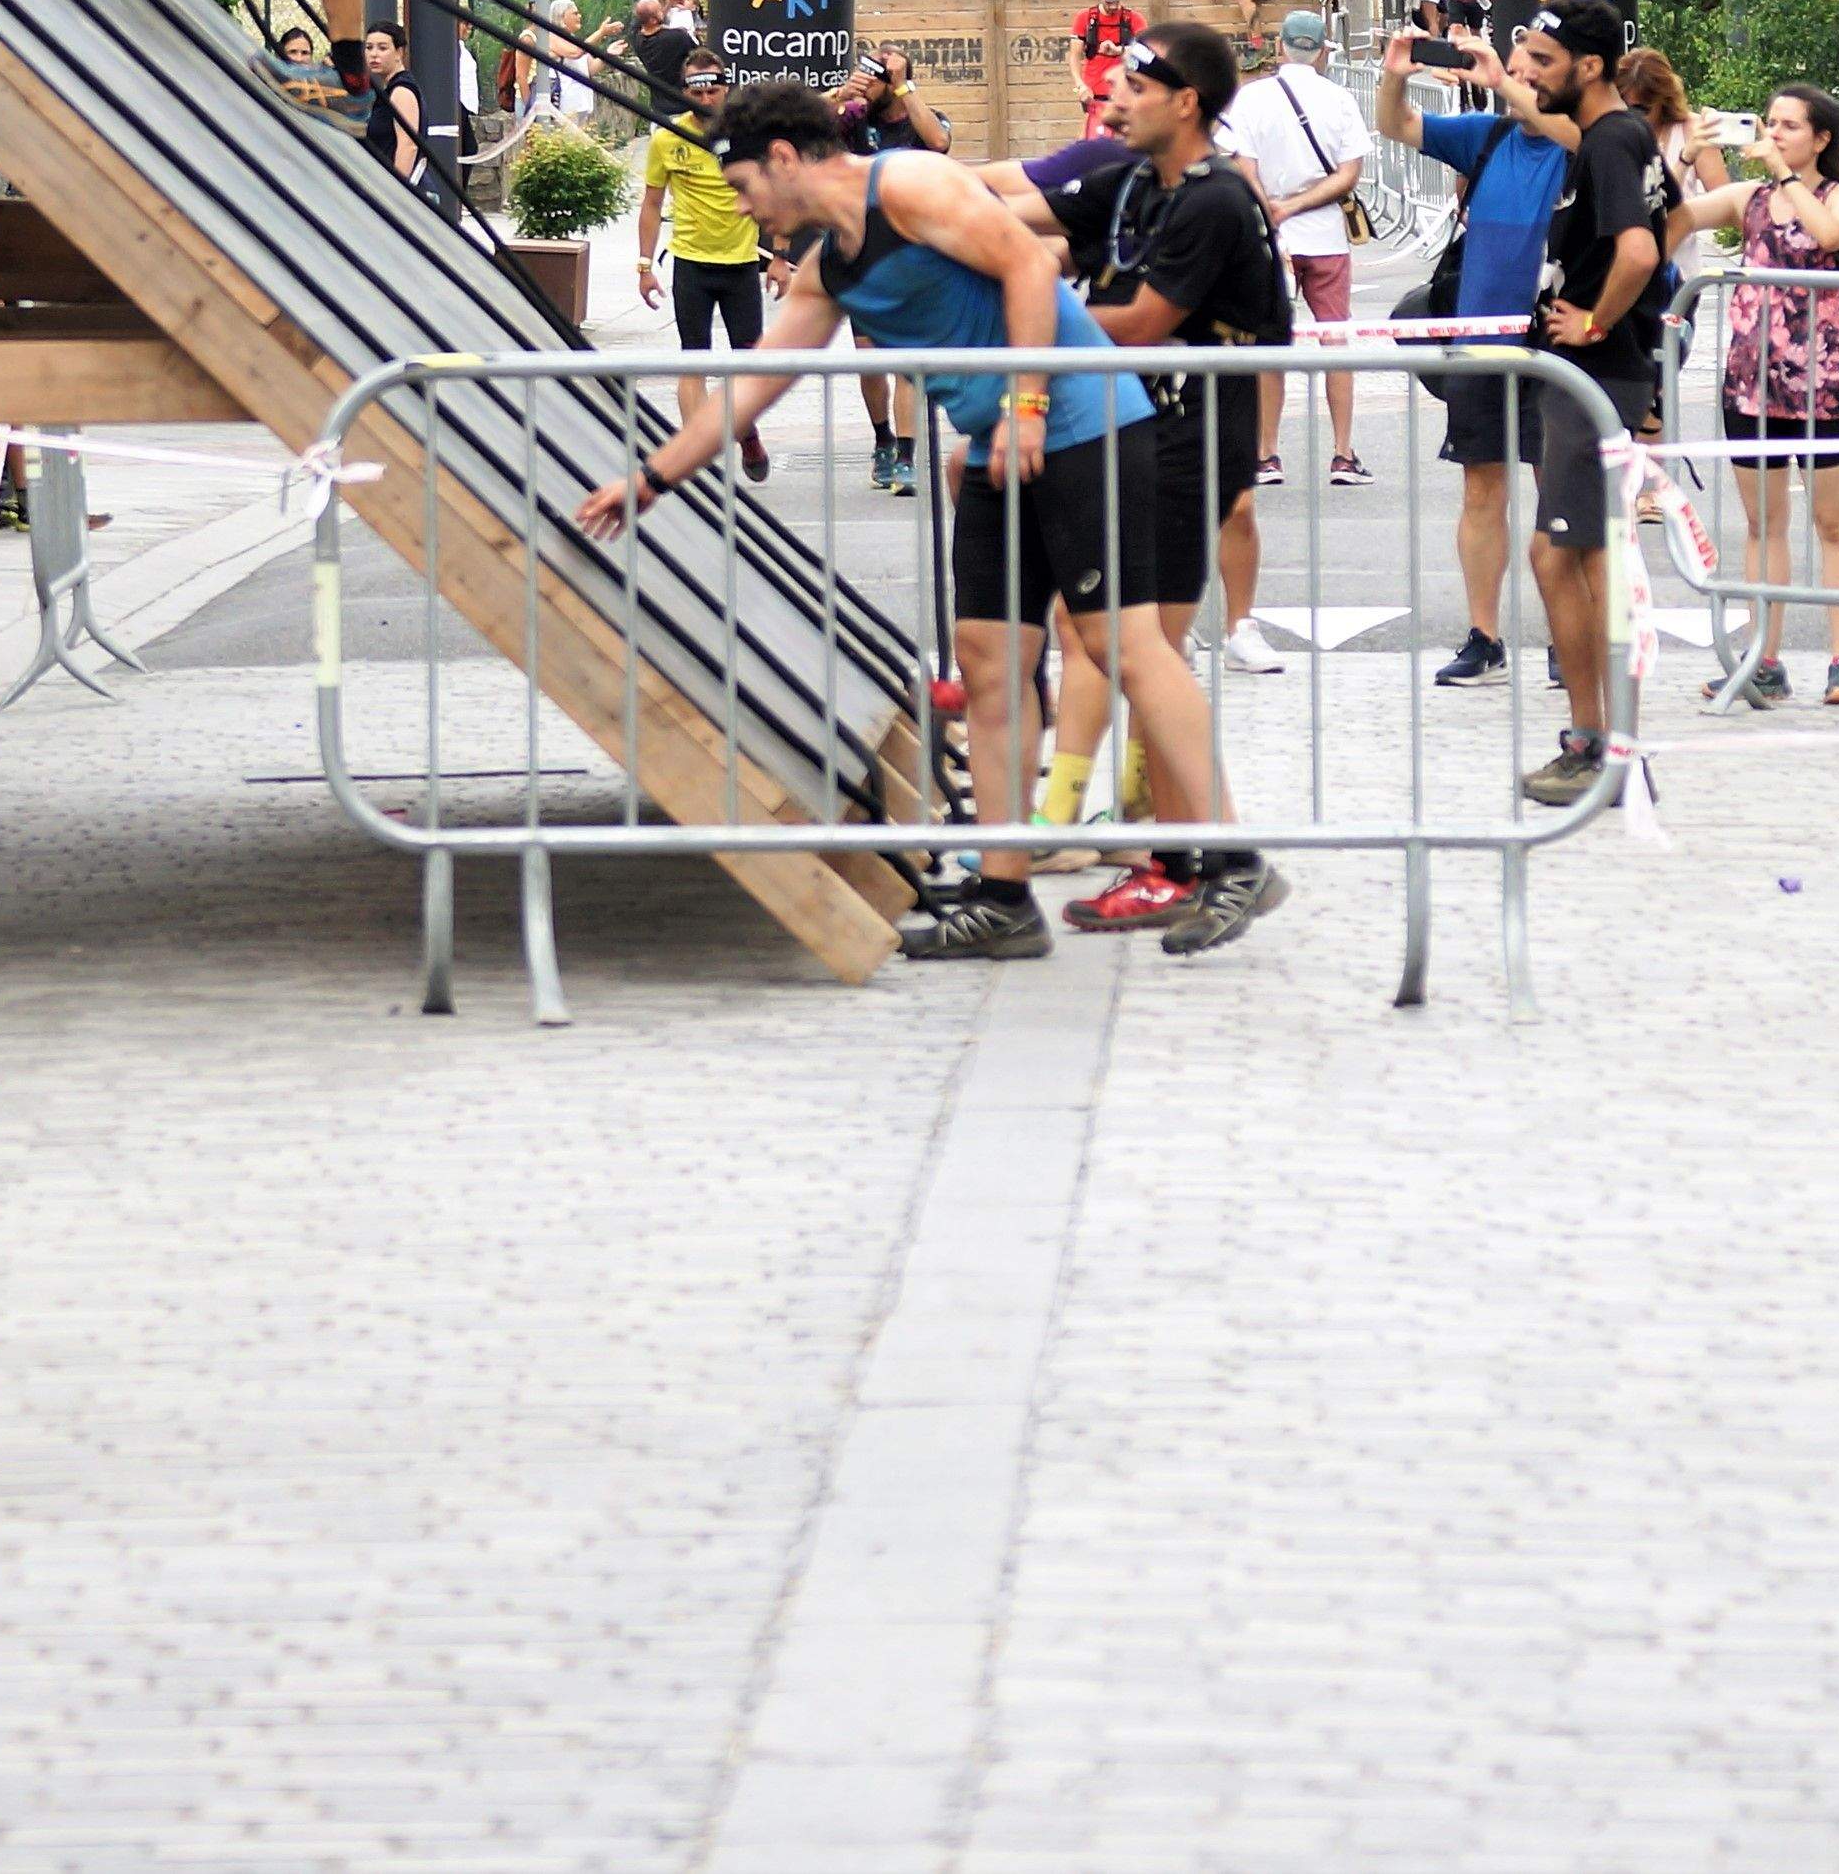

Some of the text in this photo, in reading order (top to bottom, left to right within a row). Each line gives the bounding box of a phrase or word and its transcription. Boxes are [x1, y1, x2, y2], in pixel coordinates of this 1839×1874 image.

[722, 27, 850, 66] encamp
[723, 62, 737, 84] el
[804, 65, 820, 87] la
